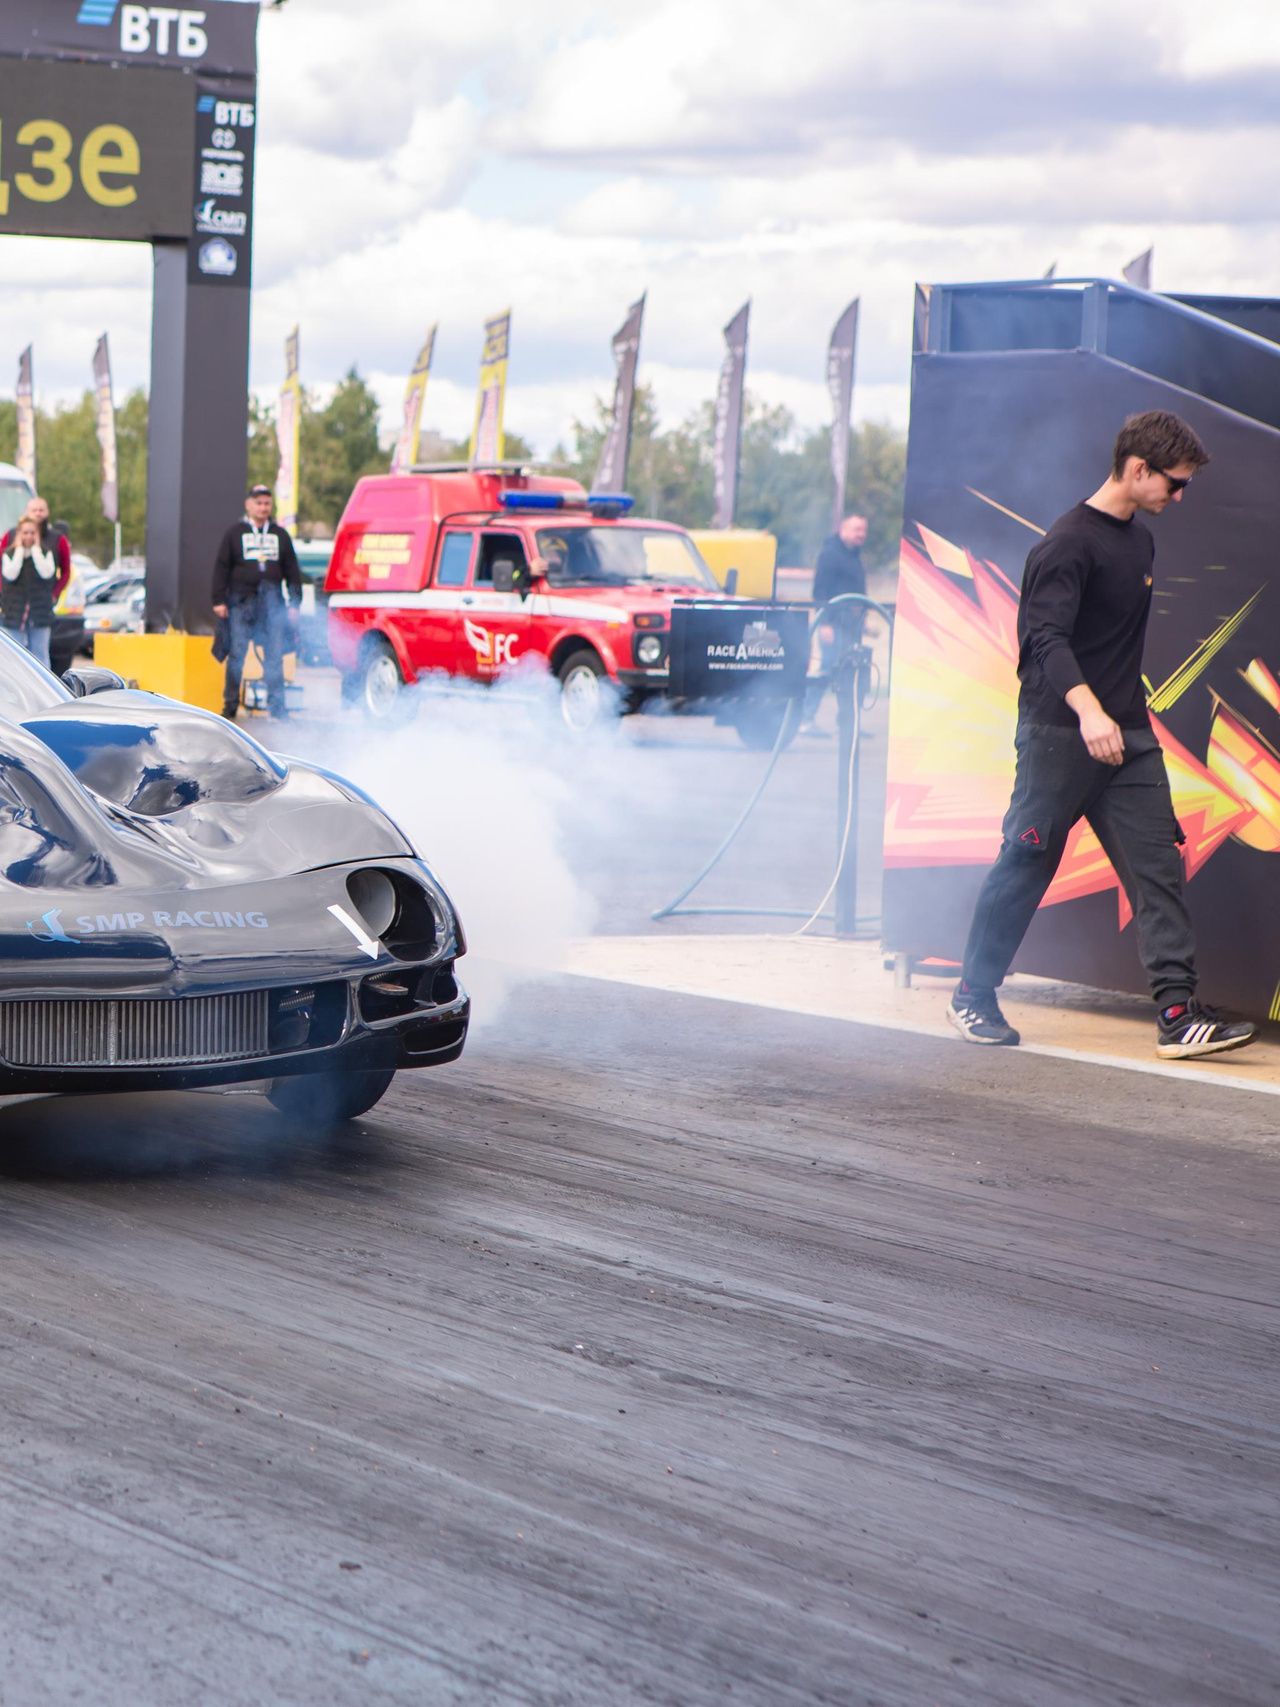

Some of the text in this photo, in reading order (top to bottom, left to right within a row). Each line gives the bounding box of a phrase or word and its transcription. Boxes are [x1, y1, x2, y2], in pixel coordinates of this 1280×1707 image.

[120, 5, 208, 58] ВТБ
[214, 101, 255, 127] ВТБ
[494, 633, 520, 665] FC
[708, 662, 784, 670] www.raceamerica.com
[76, 910, 269, 934] SMP RACING
